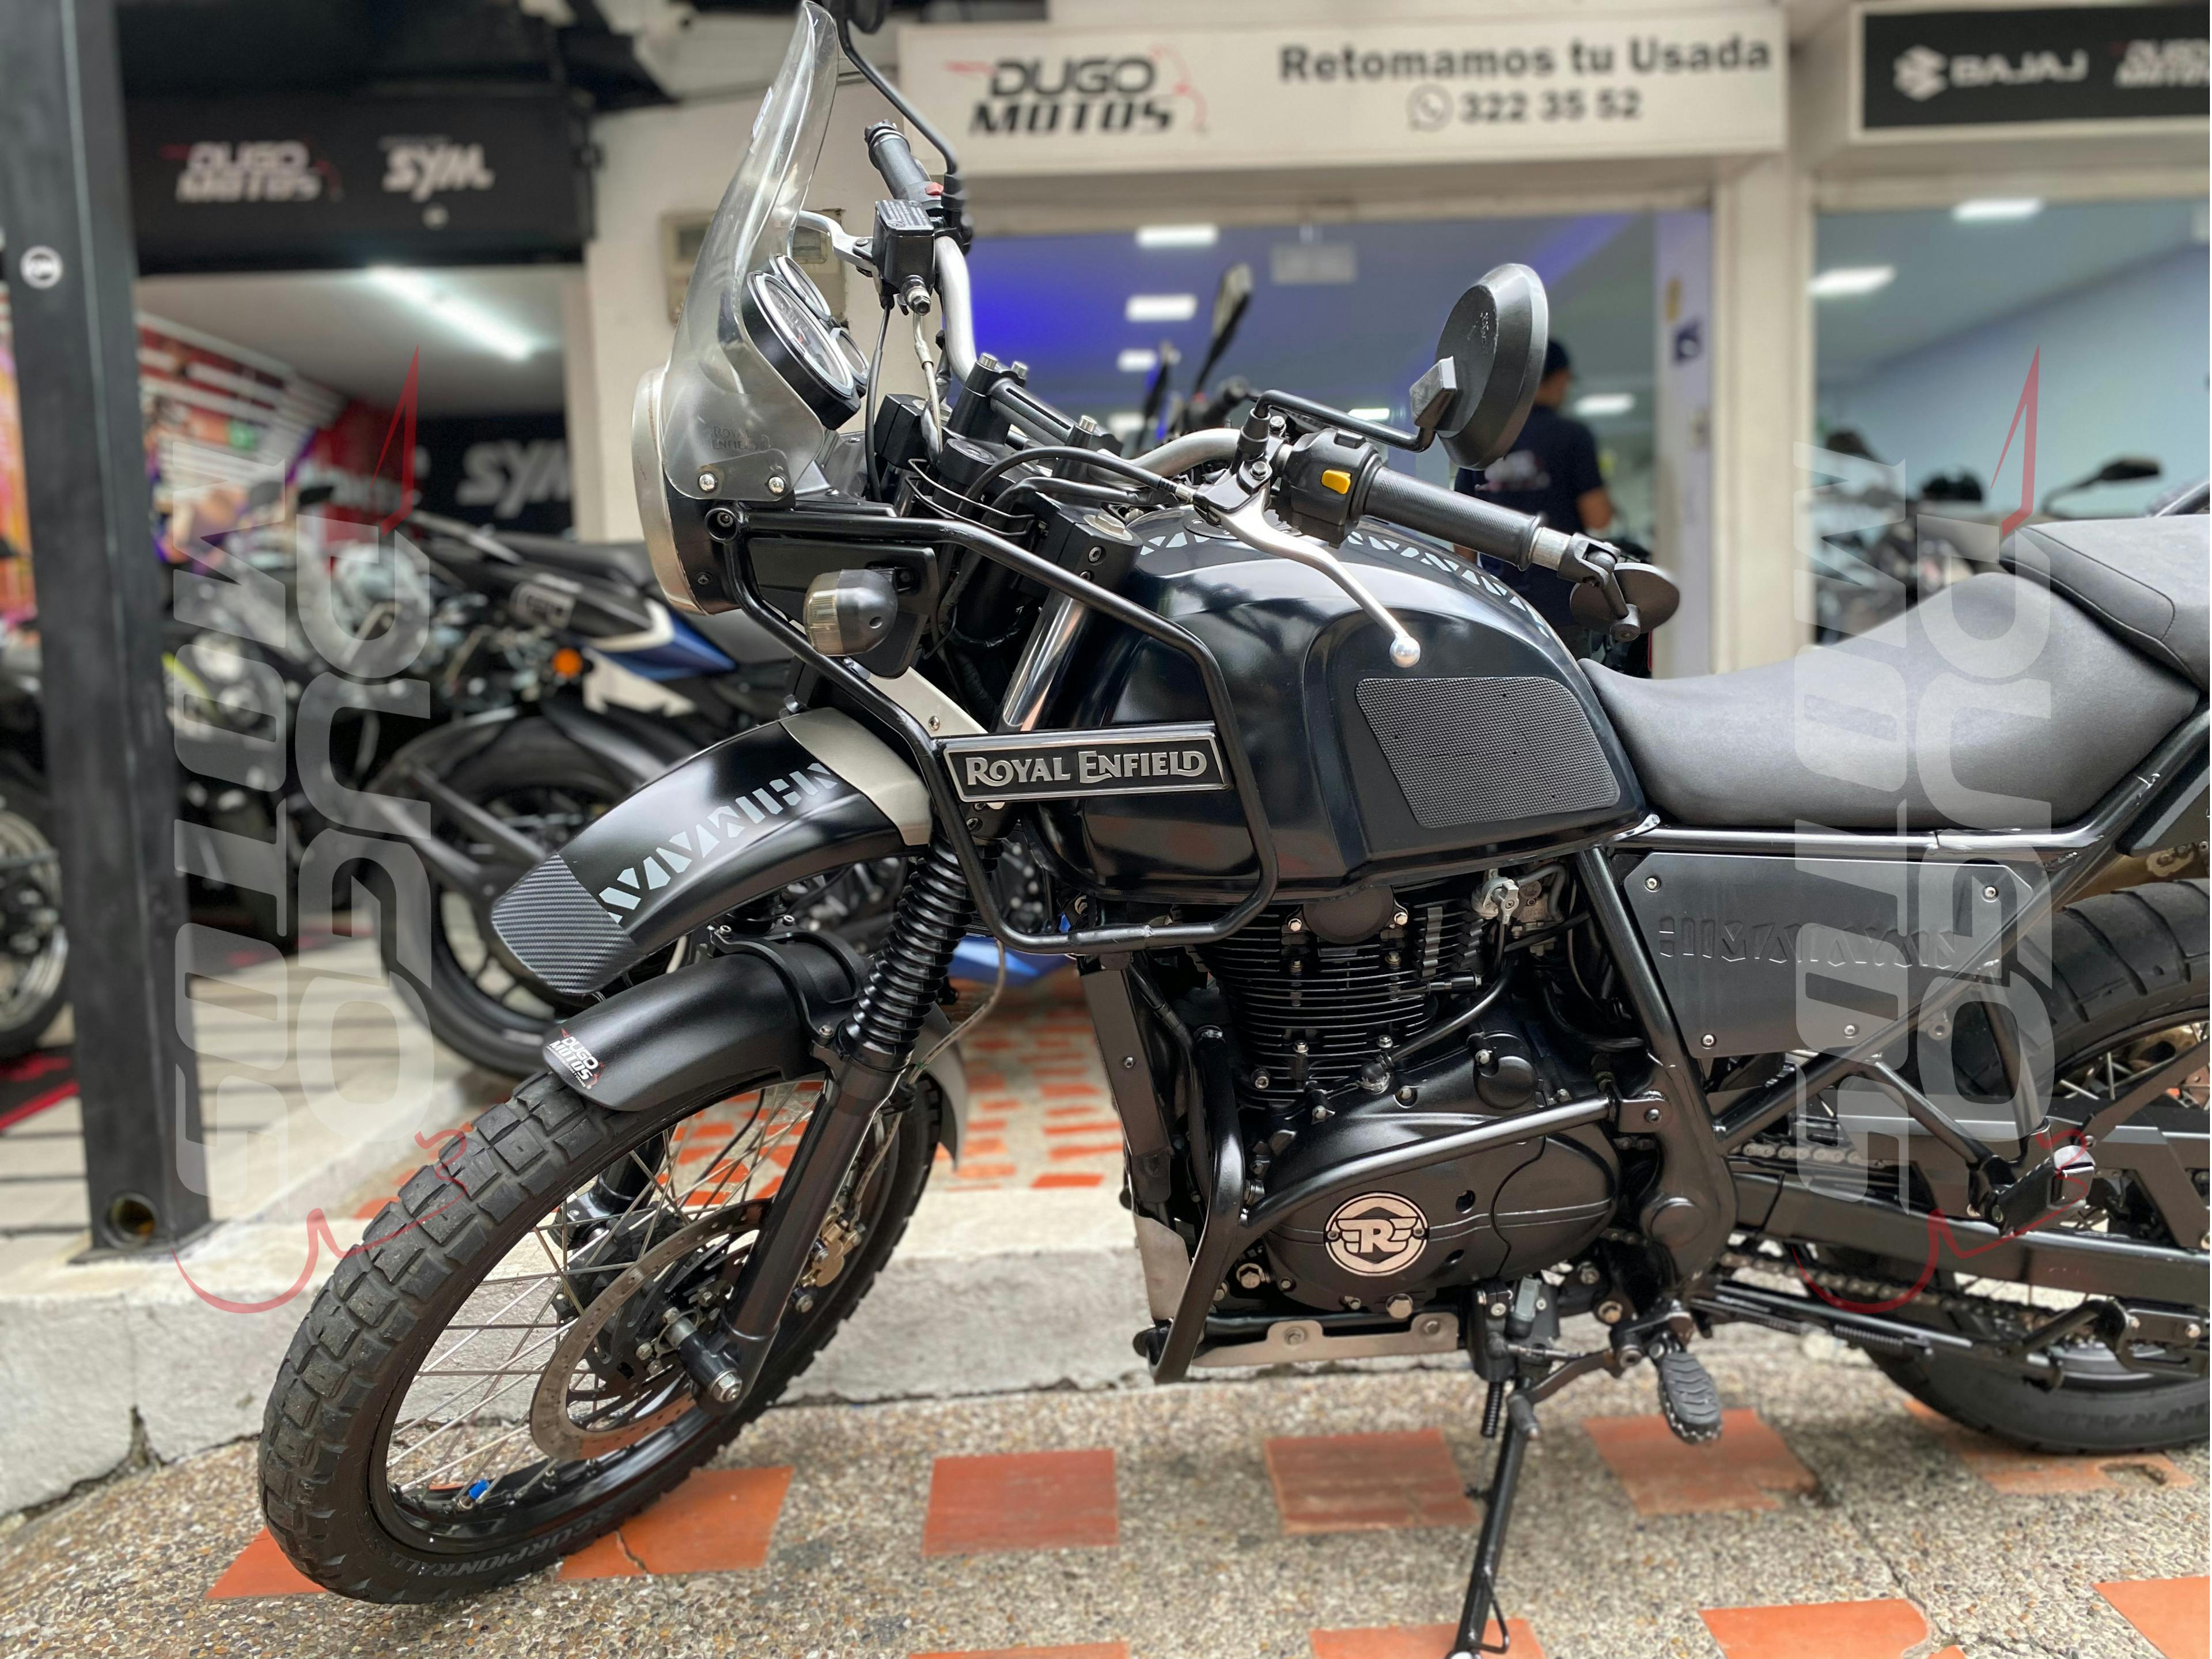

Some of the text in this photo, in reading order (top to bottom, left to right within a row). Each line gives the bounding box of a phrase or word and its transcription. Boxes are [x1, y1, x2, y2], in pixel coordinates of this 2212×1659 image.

[990, 55, 1157, 97] DUGO
[1280, 33, 1771, 82] Retomamos tu Usada
[1950, 48, 2089, 88] BAJAJ
[970, 95, 1174, 135] MOTOS
[1460, 87, 1643, 123] 322 35 52
[965, 750, 1207, 787] ROYAL ENFIELD
[548, 1040, 593, 1080] MOTOS
[561, 1036, 599, 1070] DUGO
